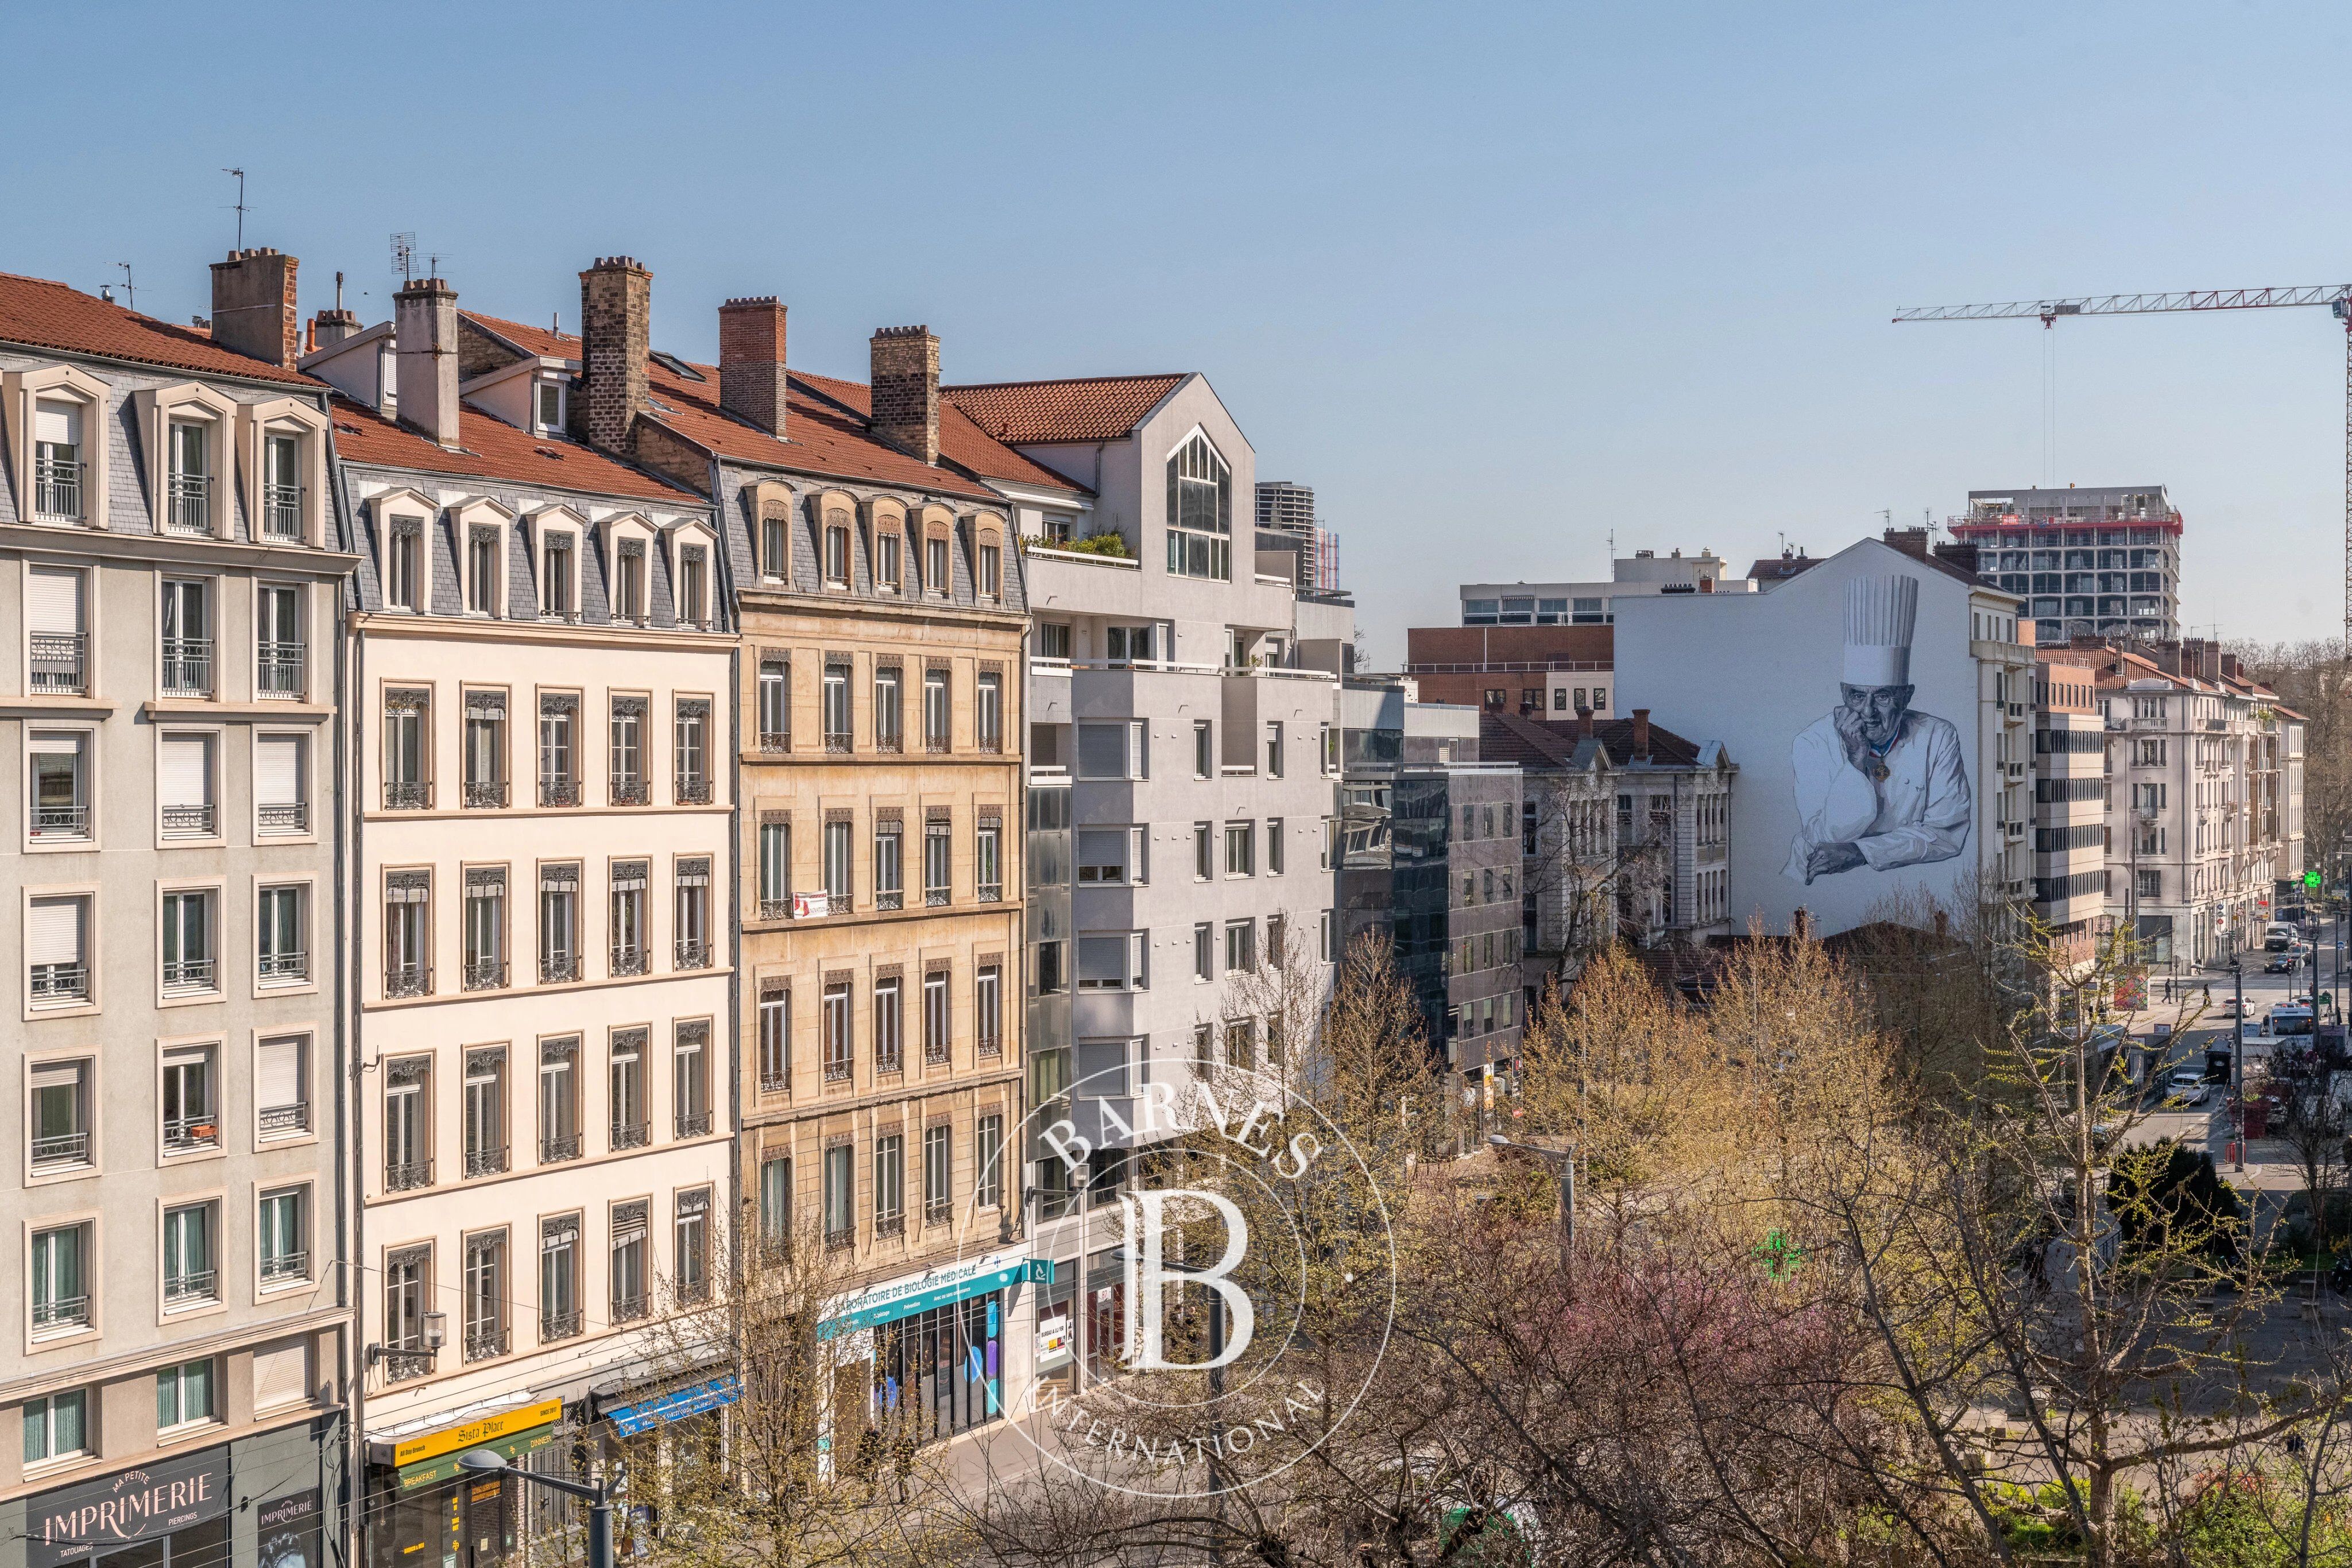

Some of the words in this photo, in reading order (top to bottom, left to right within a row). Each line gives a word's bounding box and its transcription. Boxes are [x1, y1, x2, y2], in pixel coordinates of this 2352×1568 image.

[840, 1289, 890, 1312] ABORATOIRE
[892, 1285, 903, 1298] DE
[904, 1274, 939, 1293] BIOLOGIE
[941, 1266, 976, 1284] MÉDICALE
[953, 1287, 970, 1296] ordnnance
[1041, 1329, 1052, 1338] BUREAU
[540, 1408, 549, 1416] SINCE
[549, 1406, 557, 1415] 2017
[412, 1445, 425, 1454] Brunch
[530, 1435, 552, 1449] DINNER
[112, 1478, 124, 1493] MA
[125, 1470, 150, 1485] PETITE
[404, 1469, 437, 1488] BREAKFAST
[45, 1472, 212, 1547] IMPRIMERIE
[261, 1500, 312, 1525] IMPRIMERIE
[168, 1511, 198, 1527] PIERCINGS
[60, 1542, 94, 1558] TATOUAGES
